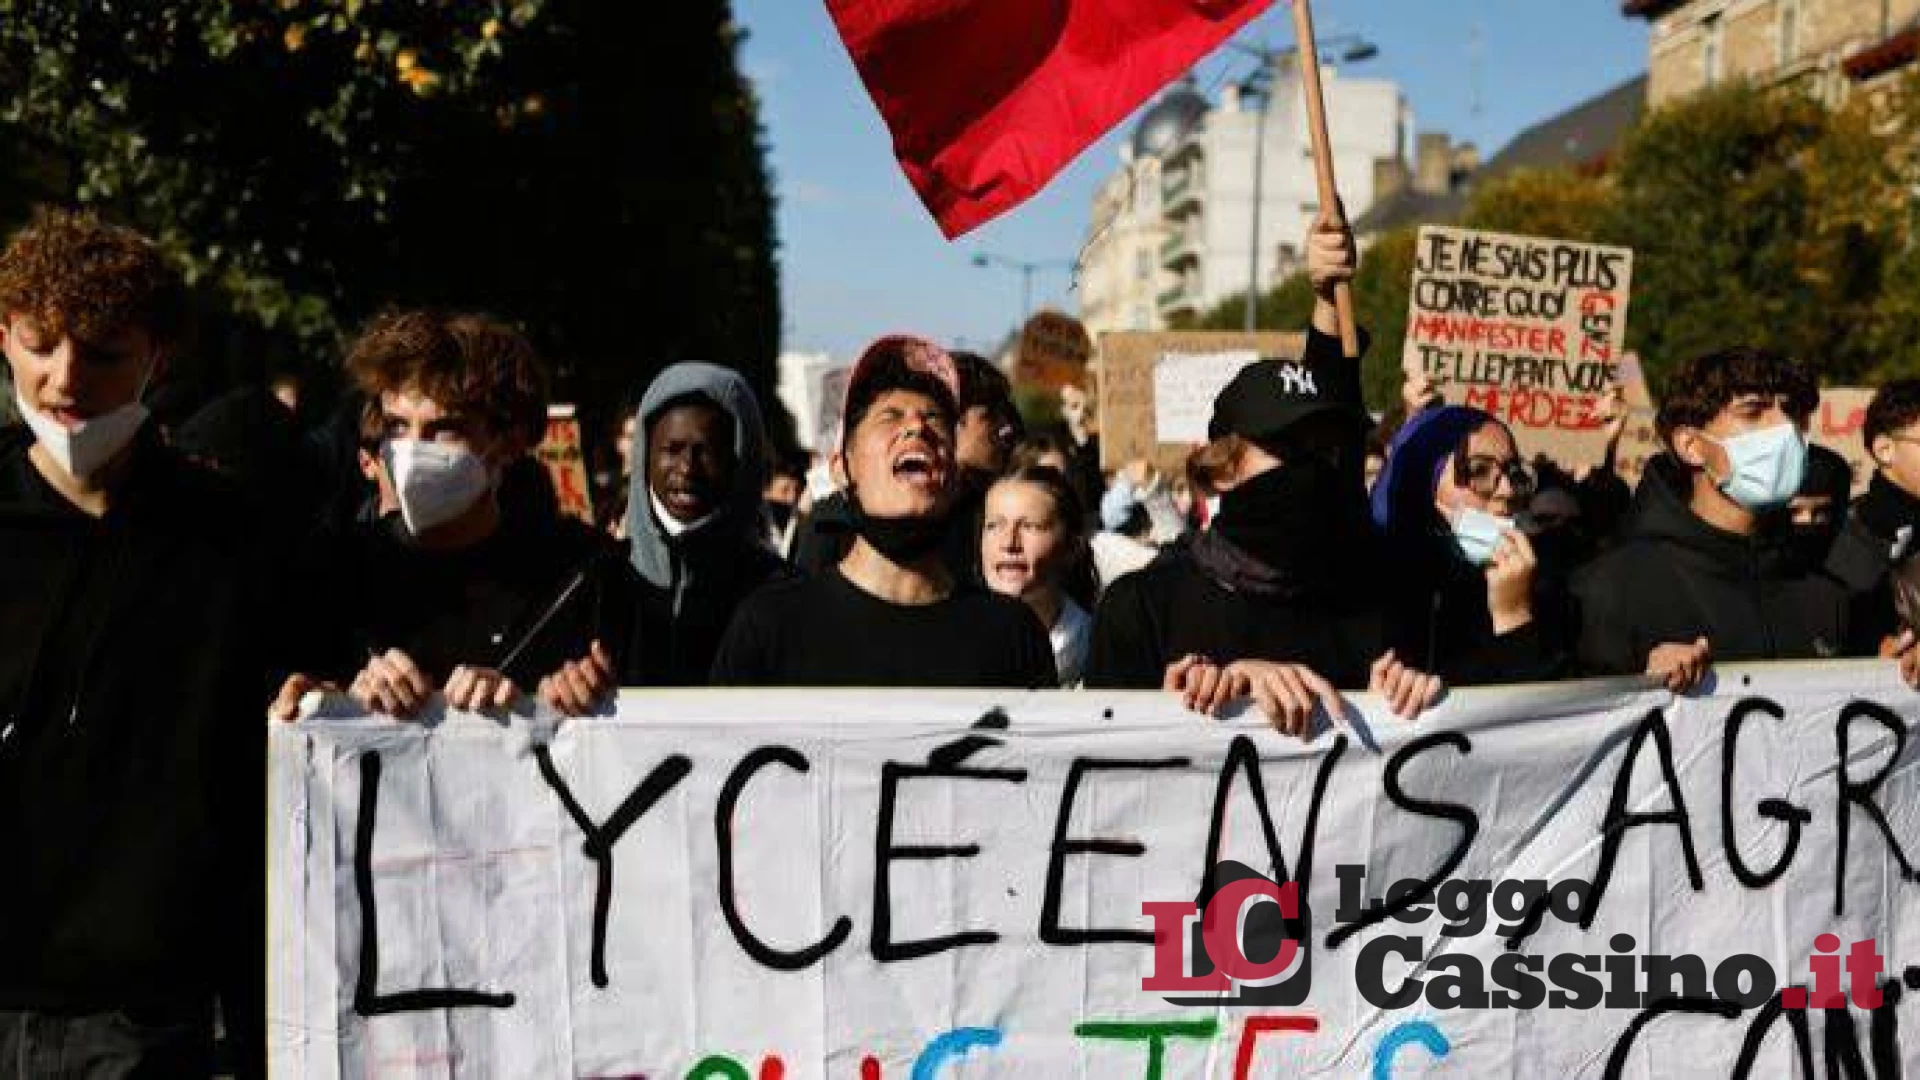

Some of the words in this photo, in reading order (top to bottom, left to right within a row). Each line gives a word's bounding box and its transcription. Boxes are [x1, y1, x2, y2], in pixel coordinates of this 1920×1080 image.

[1417, 234, 1458, 274] JE
[1459, 236, 1496, 277] NE
[1495, 243, 1547, 282] SAIS
[1553, 246, 1625, 291] PLUS
[1416, 278, 1500, 318] CONTRE
[1506, 285, 1567, 320] QUOI
[1414, 314, 1567, 358] MANIFESTER
[1418, 345, 1566, 389] TELLEMENT
